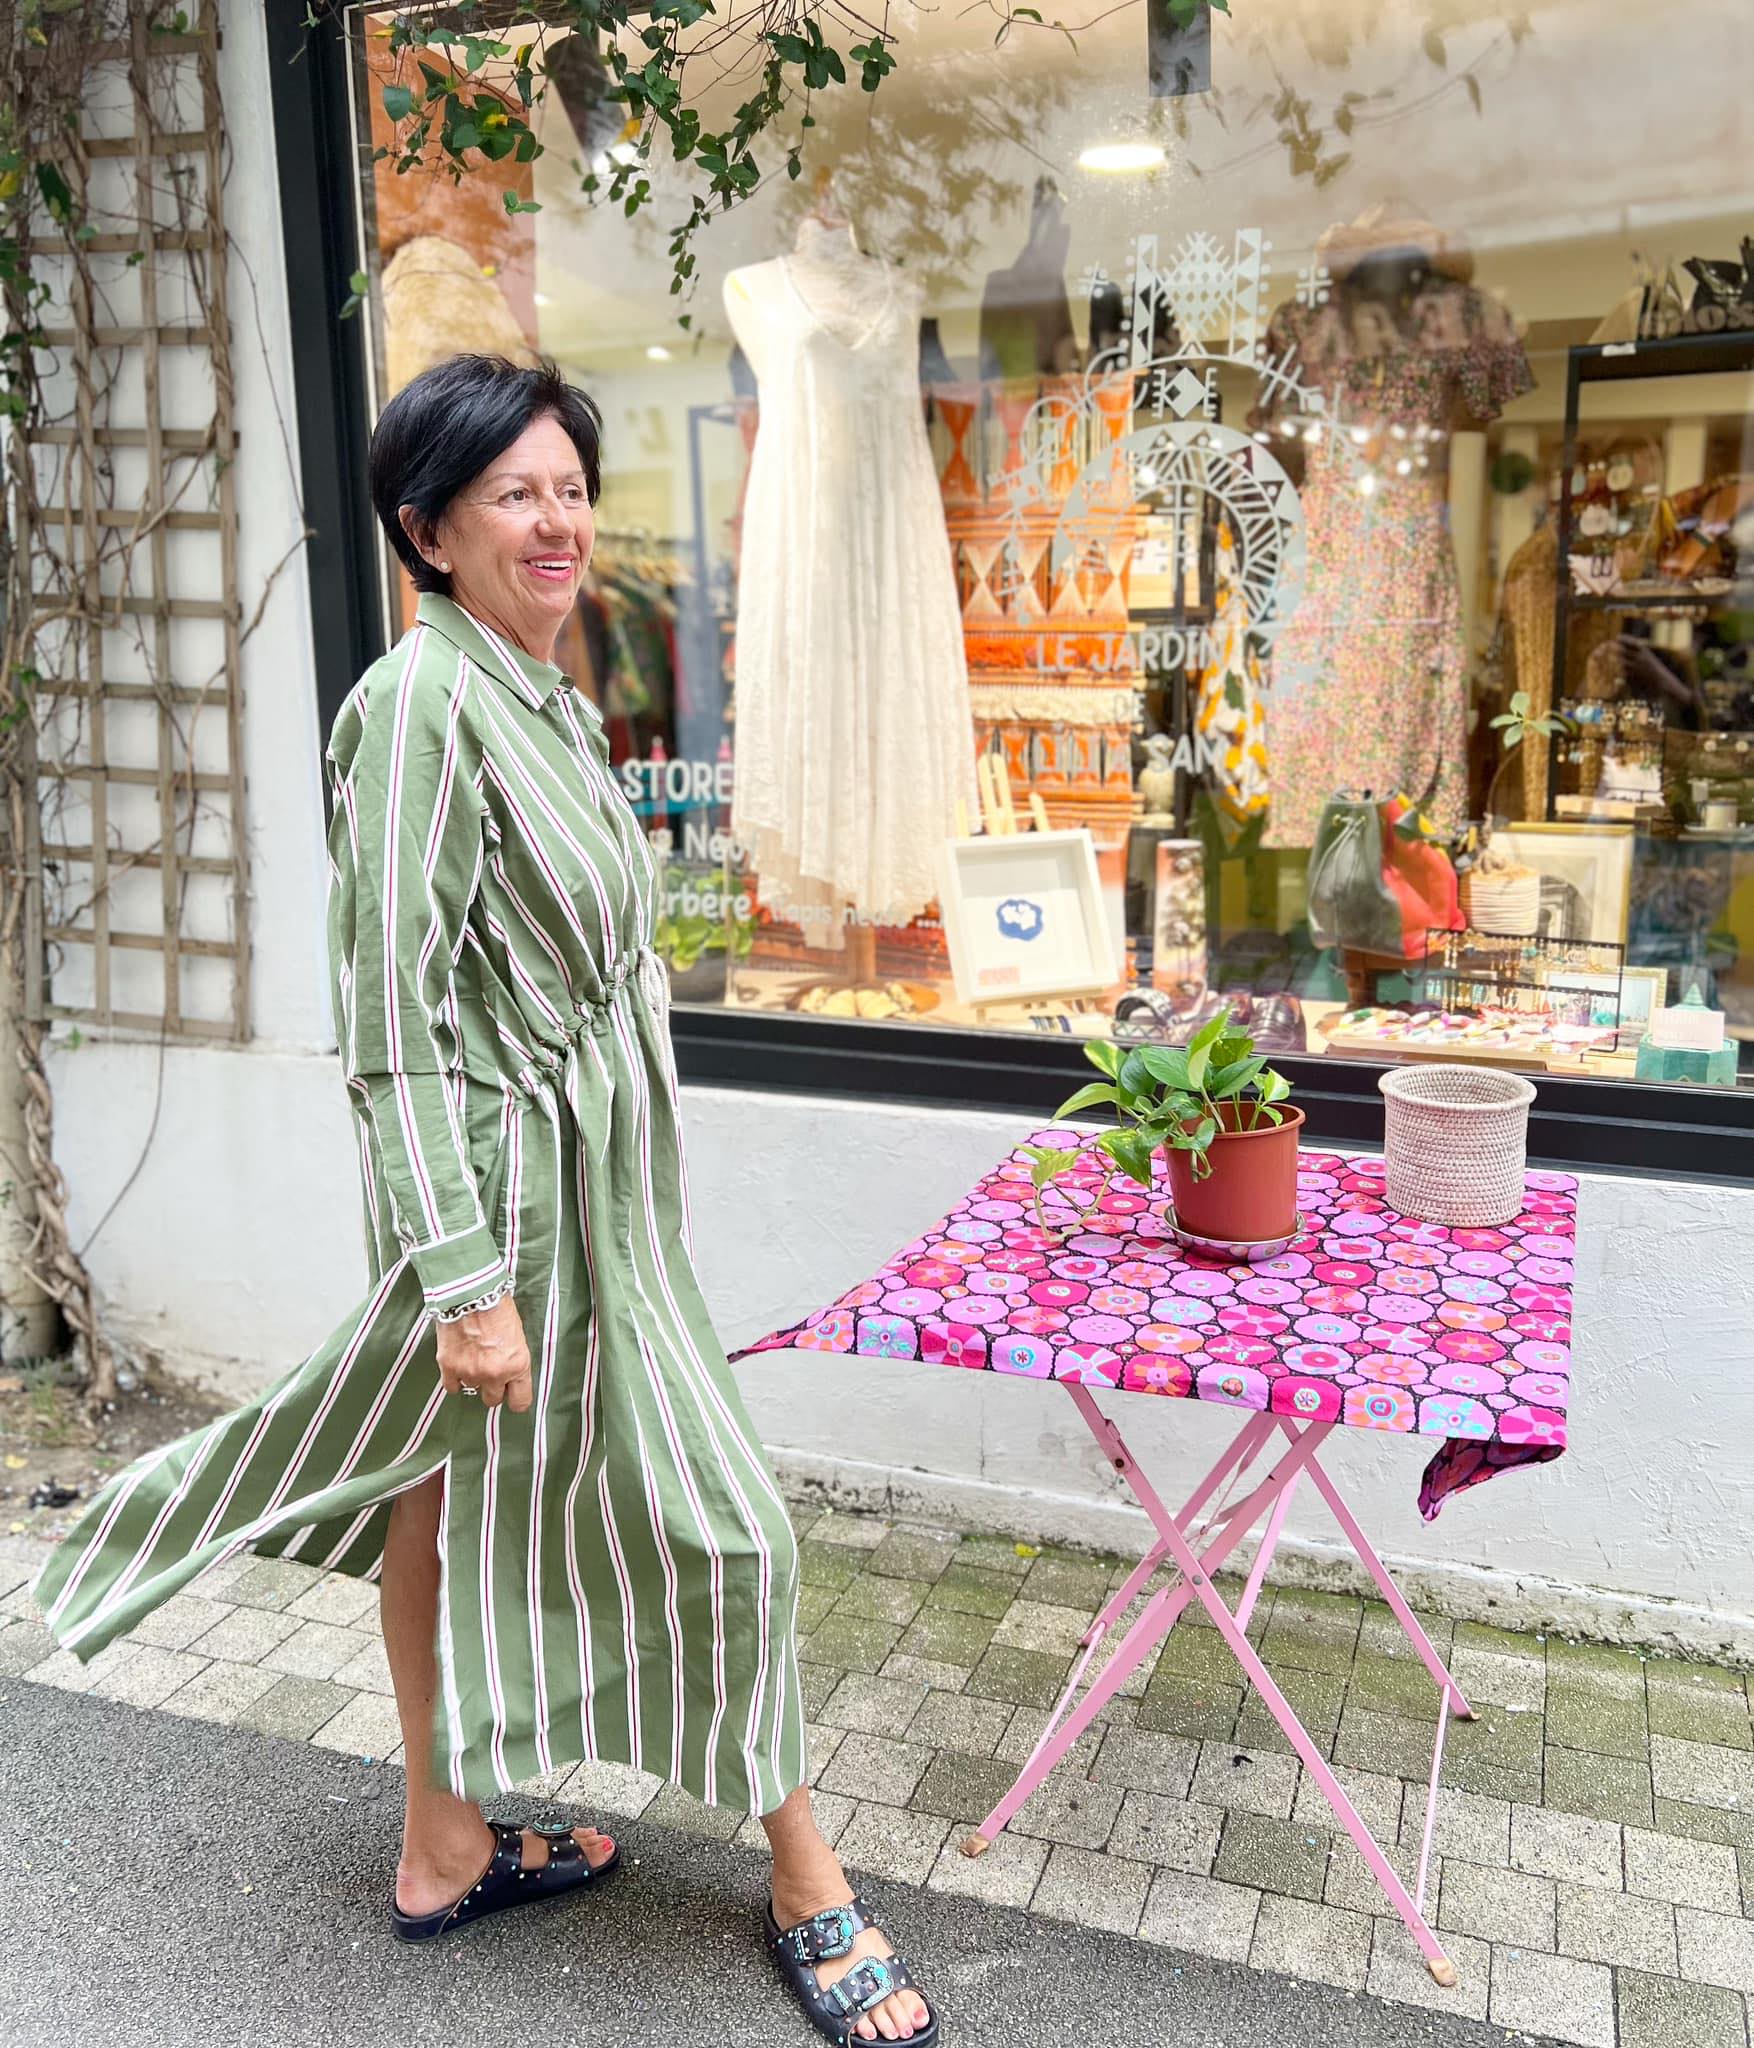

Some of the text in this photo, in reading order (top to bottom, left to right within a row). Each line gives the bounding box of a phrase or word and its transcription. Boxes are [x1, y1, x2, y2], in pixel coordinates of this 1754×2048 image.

[1037, 630, 1225, 673] LE JARDIN
[1113, 692, 1146, 725] DE
[621, 757, 736, 804] STORE
